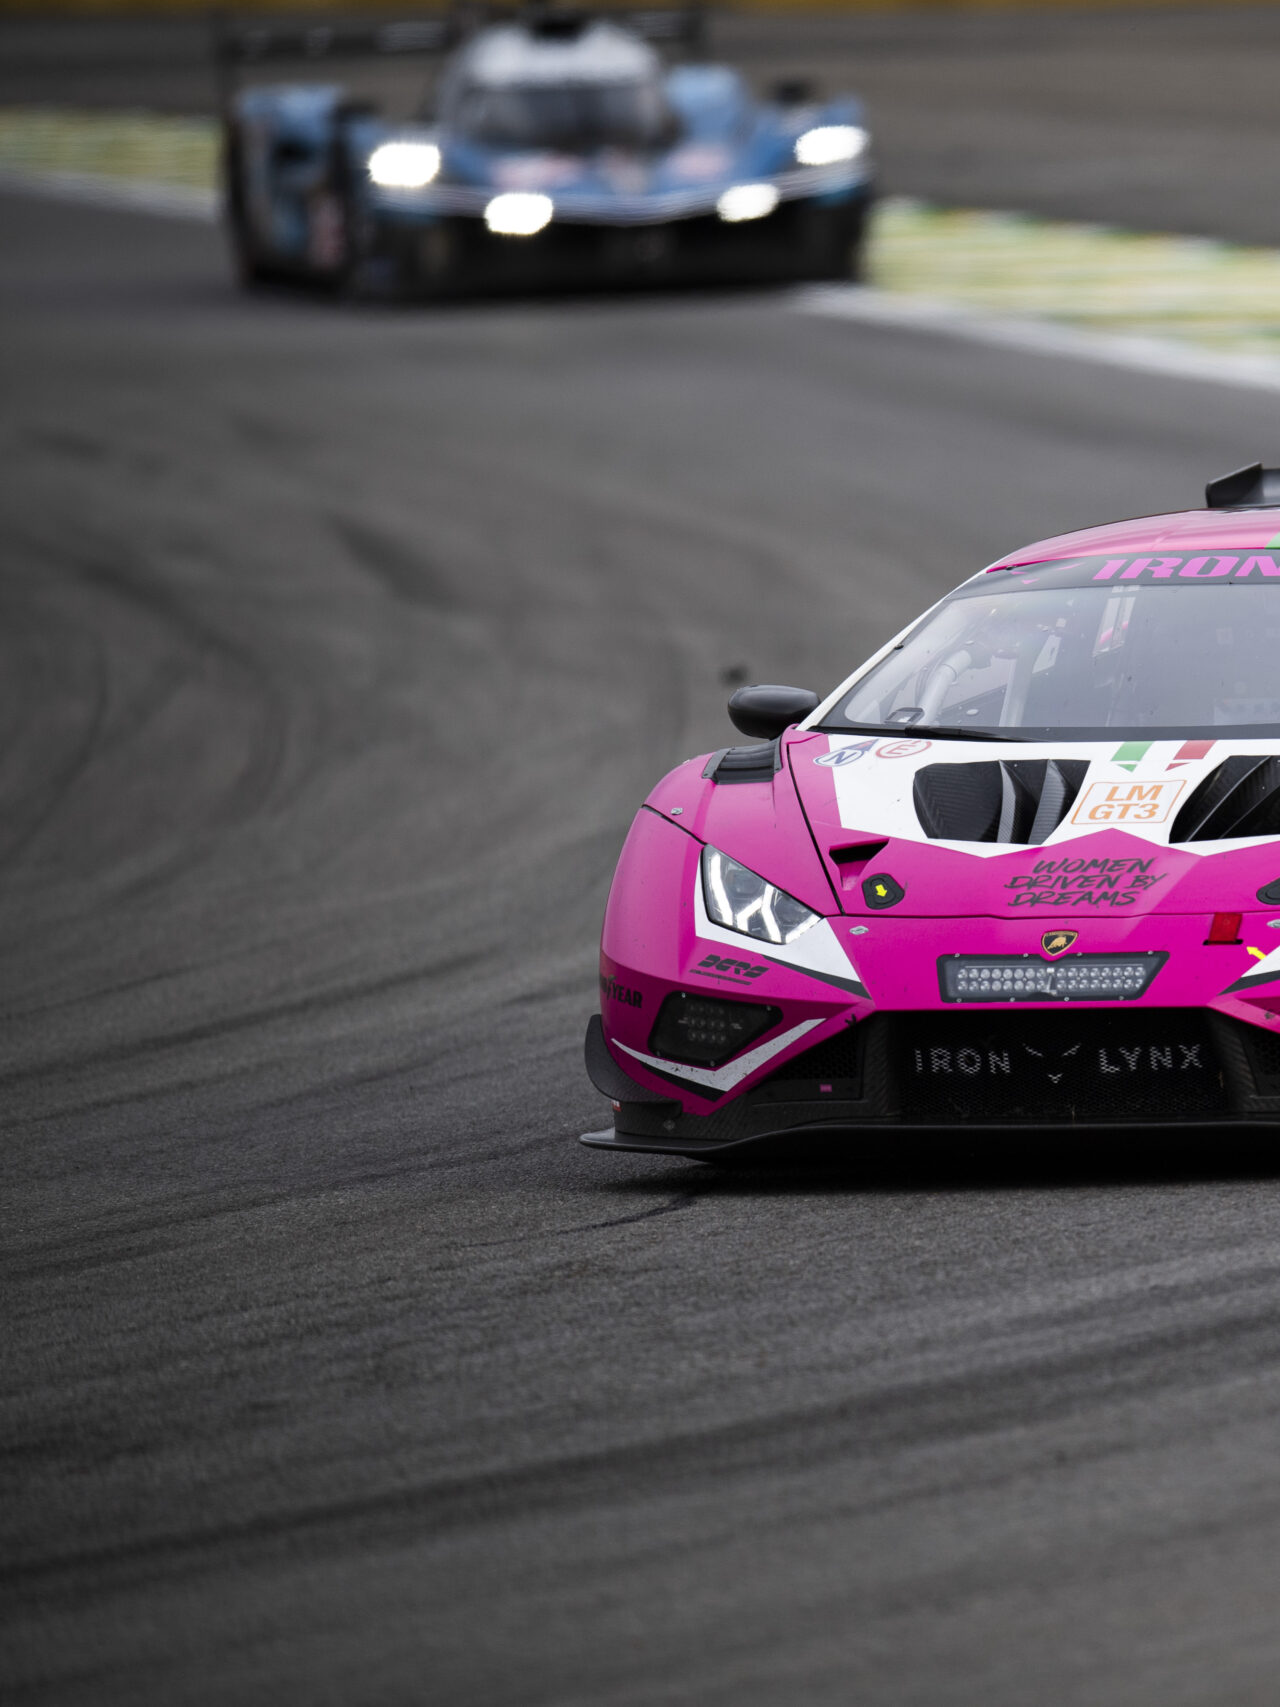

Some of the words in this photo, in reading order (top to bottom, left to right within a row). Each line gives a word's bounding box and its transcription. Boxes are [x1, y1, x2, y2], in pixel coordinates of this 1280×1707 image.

[1105, 784, 1164, 802] LM
[1089, 803, 1160, 819] GT3
[1033, 857, 1154, 874] WOMEN
[1004, 872, 1123, 890] DRIVEN
[1124, 872, 1168, 890] BY
[1007, 890, 1141, 908] DREAMS
[914, 1048, 1011, 1074] IRON
[1099, 1044, 1203, 1073] LYNX
